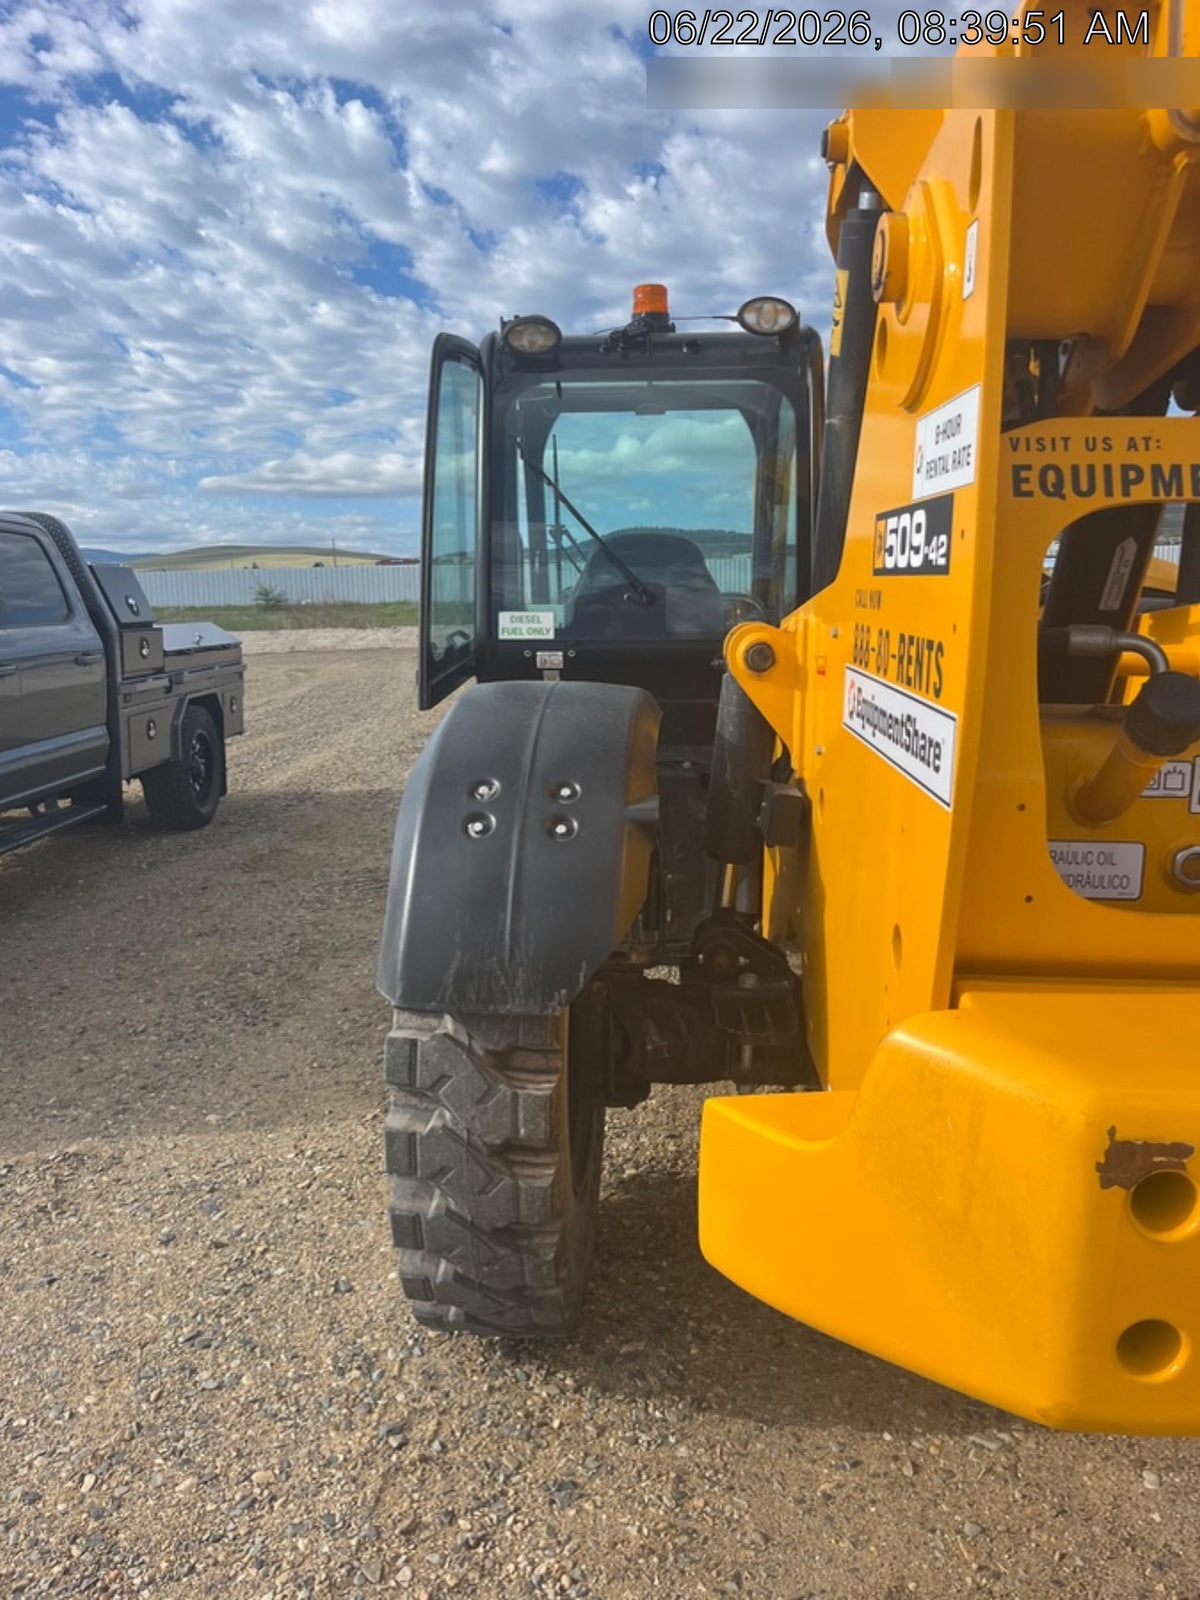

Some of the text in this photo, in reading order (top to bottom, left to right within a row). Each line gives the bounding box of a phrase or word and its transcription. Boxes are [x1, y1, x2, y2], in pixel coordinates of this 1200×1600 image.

[1009, 436, 1161, 452] VISIT US AT:
[509, 614, 542, 625] DIESEL
[501, 626, 552, 636] FUEL ONLY
[855, 686, 942, 774] EquipmentShare
[1095, 850, 1117, 867] OIL
